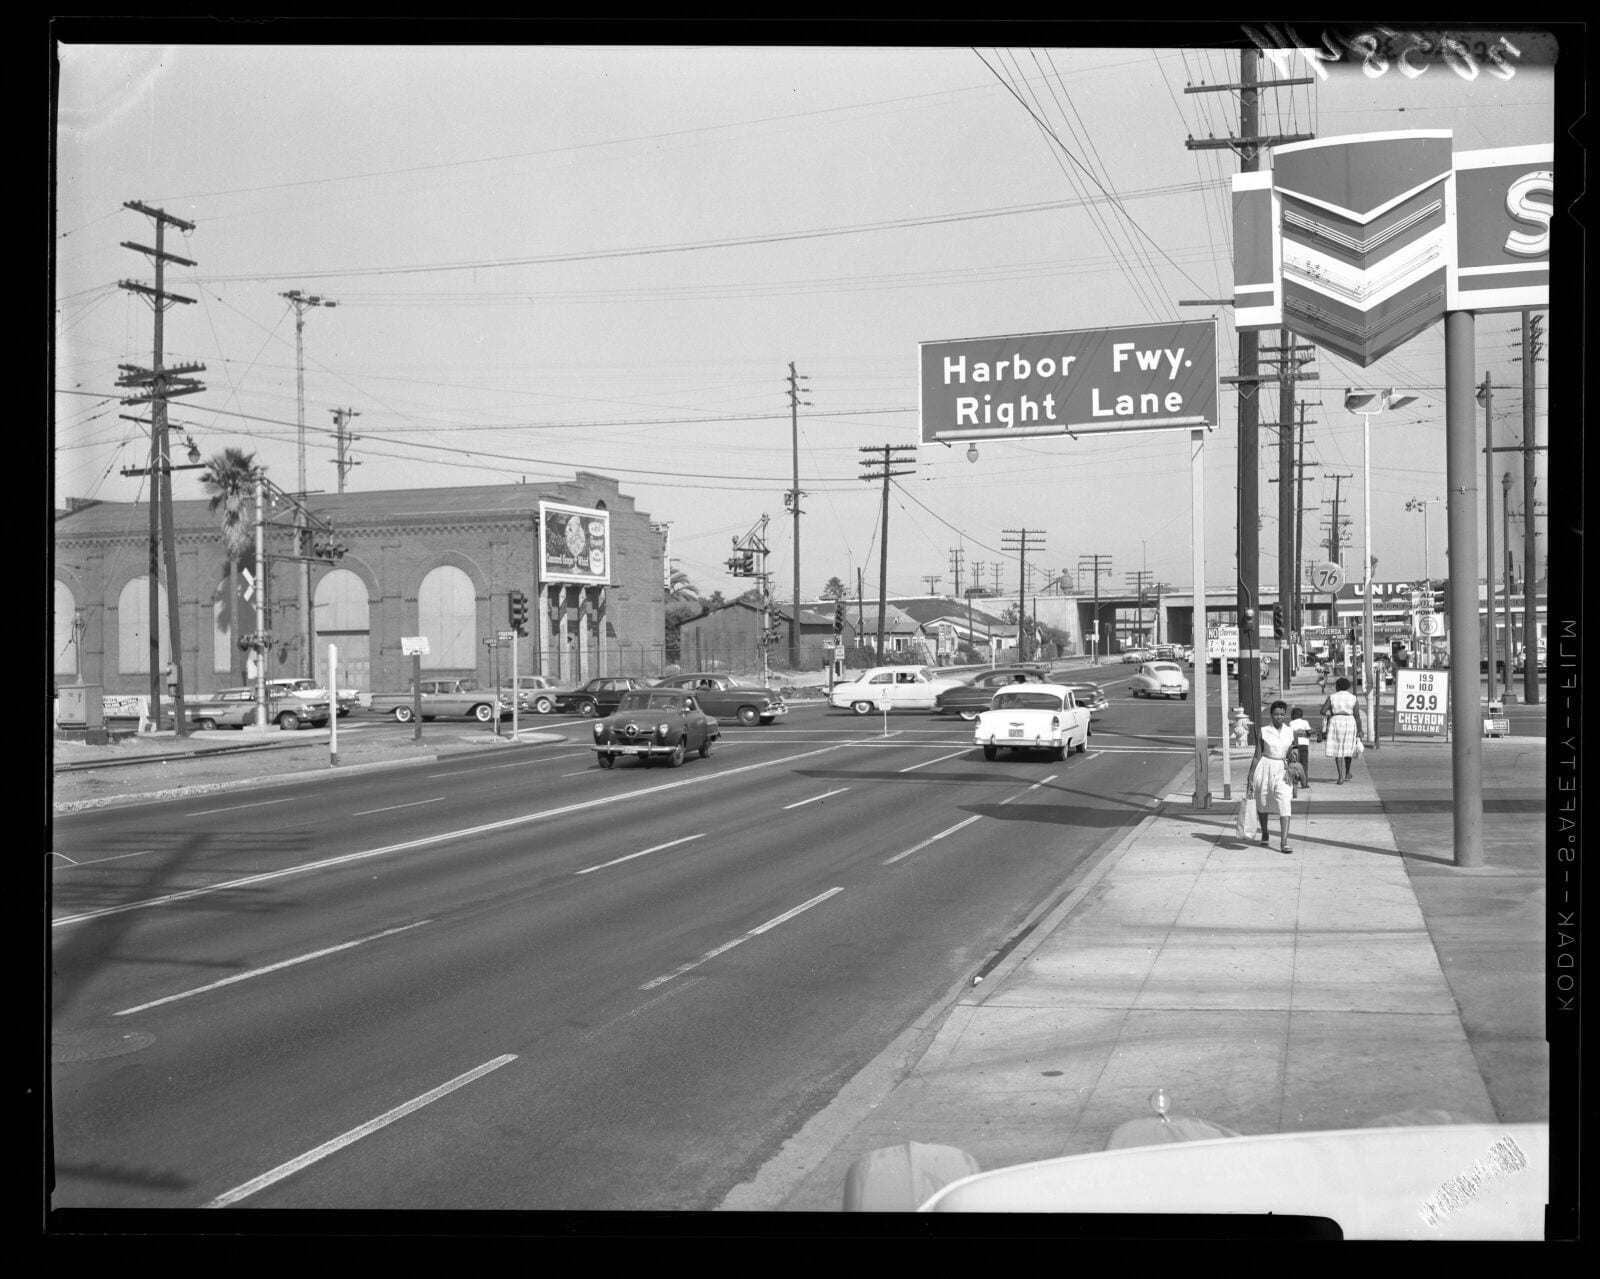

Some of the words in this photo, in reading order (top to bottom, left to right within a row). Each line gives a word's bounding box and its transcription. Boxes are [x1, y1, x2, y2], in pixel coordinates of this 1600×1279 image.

[943, 353, 1077, 385] Harbor
[1112, 342, 1193, 381] Fwy.
[956, 393, 1057, 429] Right
[1091, 387, 1184, 417] Lane
[1319, 569, 1338, 587] 76
[1208, 628, 1218, 639] NO
[1419, 673, 1434, 683] 19.9
[1419, 683, 1434, 692] 10.0
[1405, 693, 1438, 711] 29.9
[1398, 712, 1444, 726] CHEVRON
[1402, 724, 1441, 733] GASOLINE
